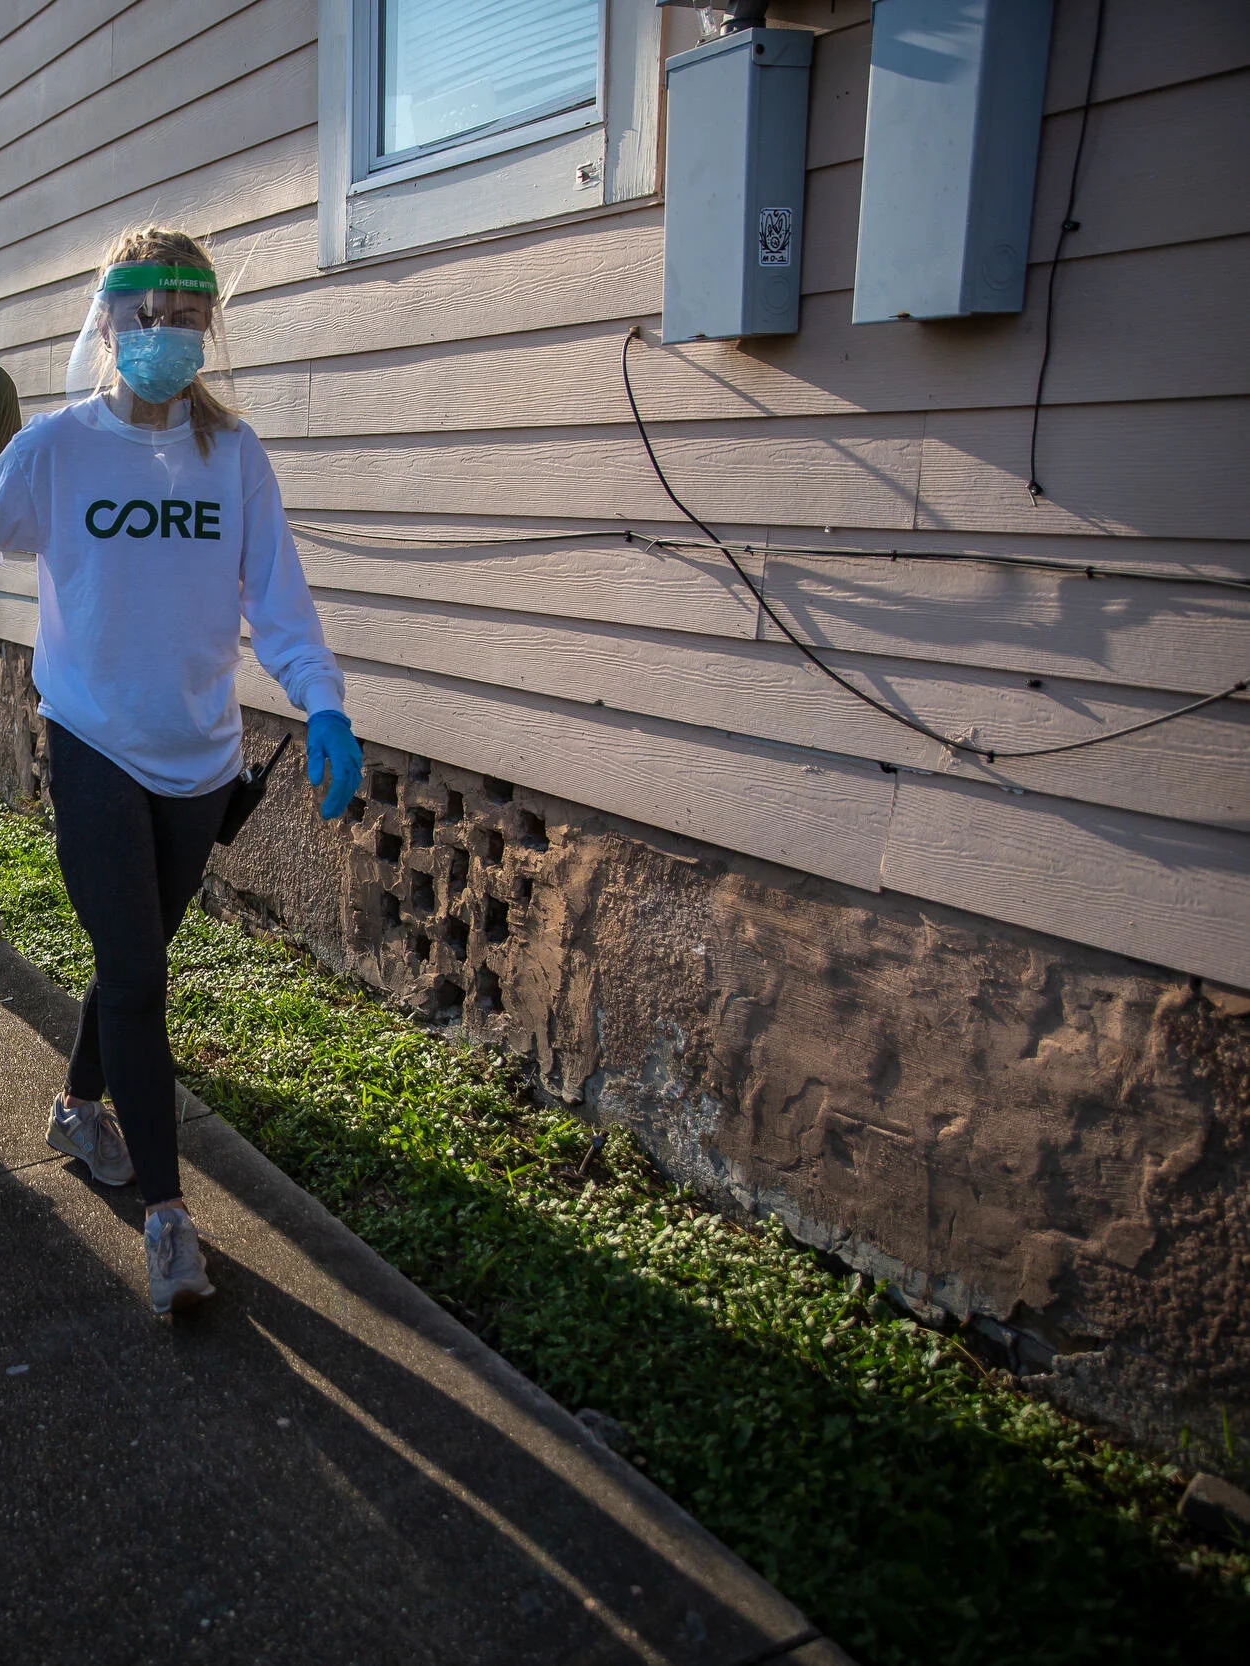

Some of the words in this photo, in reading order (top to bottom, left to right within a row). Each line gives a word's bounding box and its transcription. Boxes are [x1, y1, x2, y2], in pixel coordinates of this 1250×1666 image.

[164, 279, 178, 287] AM
[179, 279, 198, 288] HERE
[85, 499, 221, 540] CORE
